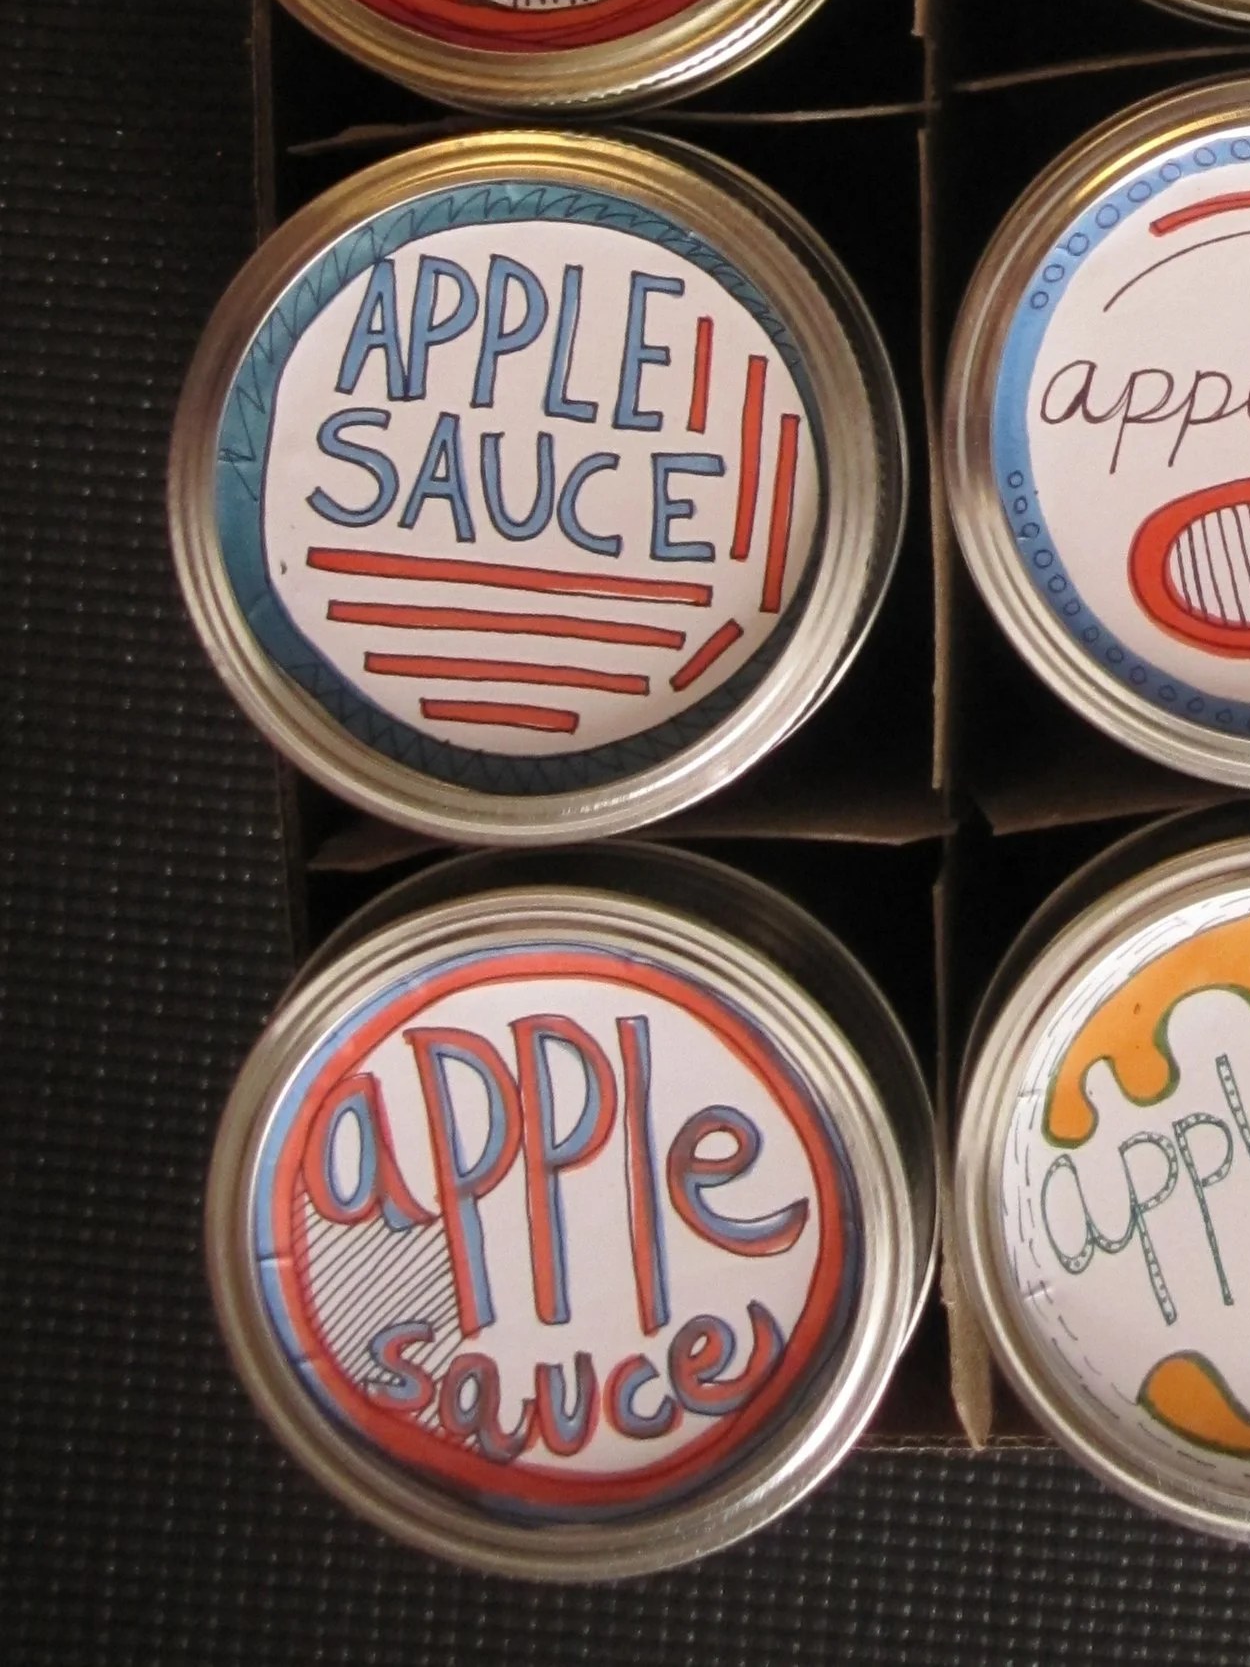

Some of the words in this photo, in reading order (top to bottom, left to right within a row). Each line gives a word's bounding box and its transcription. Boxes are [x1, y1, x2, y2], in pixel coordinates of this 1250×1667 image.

[335, 254, 685, 431] APPLE
[307, 408, 726, 562] SAUCE
[303, 1013, 810, 1339] apple
[361, 1299, 785, 1462] sauce
